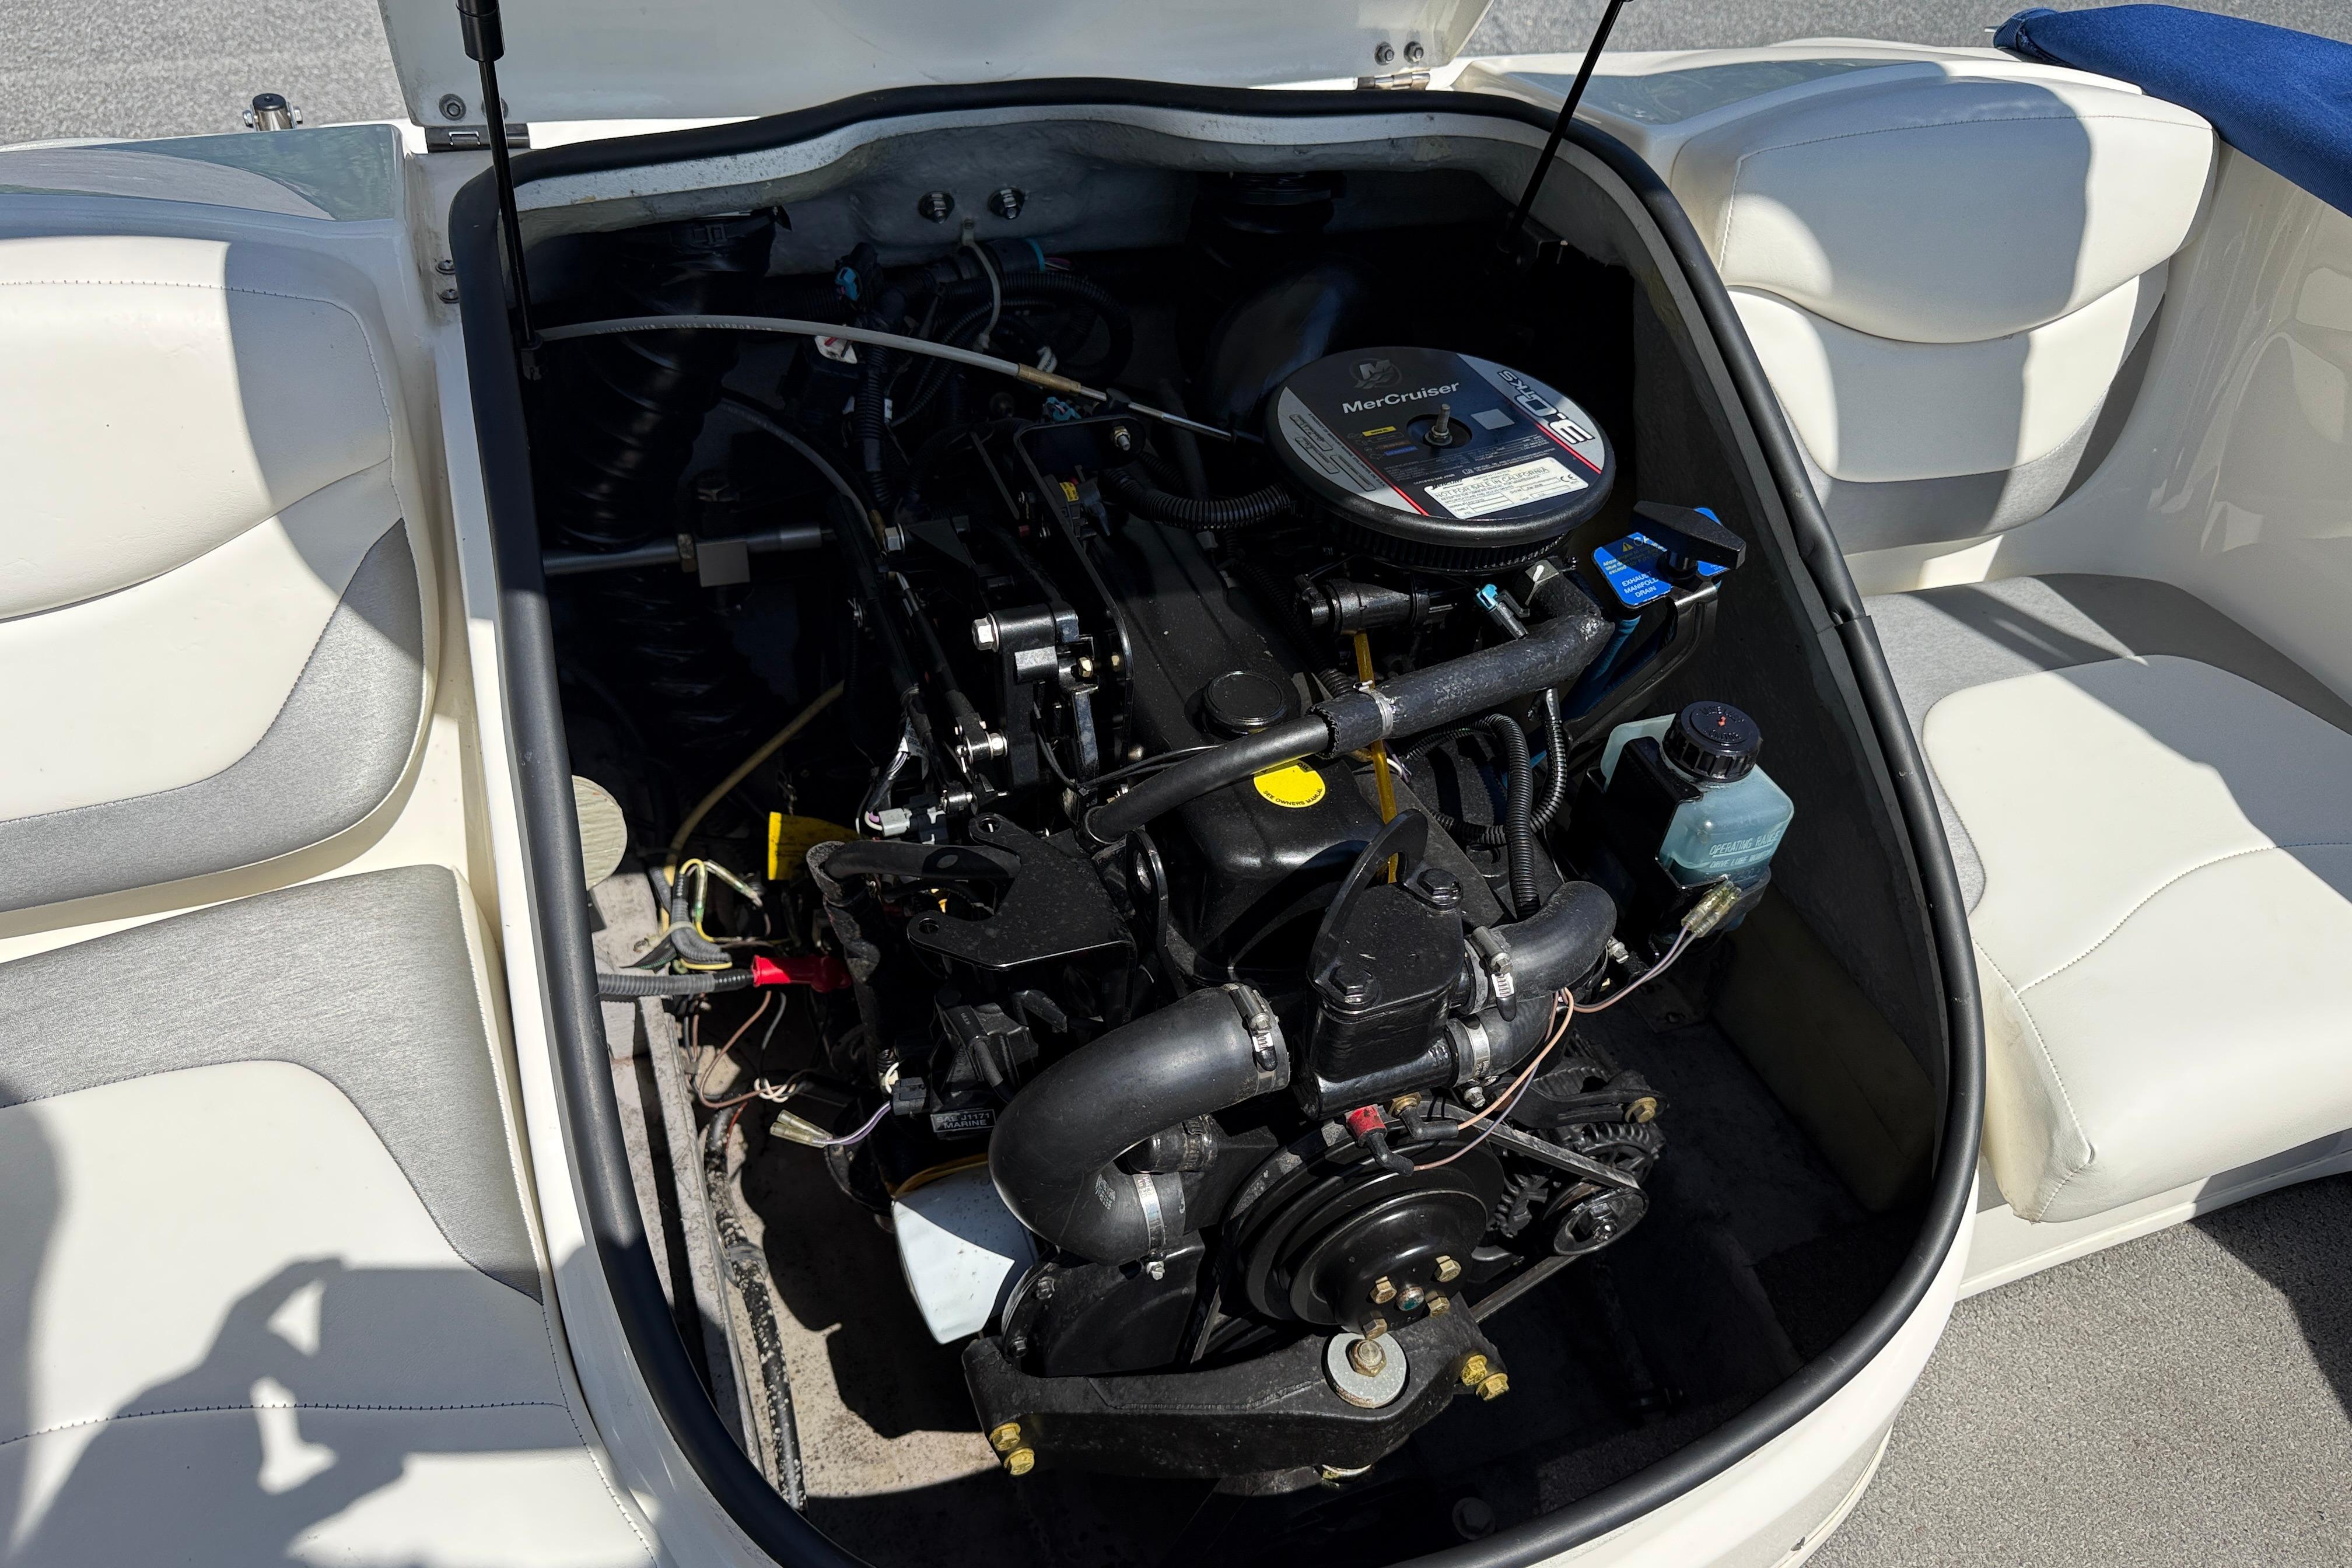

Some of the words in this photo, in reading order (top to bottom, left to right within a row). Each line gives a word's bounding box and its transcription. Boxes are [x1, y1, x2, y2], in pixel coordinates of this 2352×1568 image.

[1342, 382, 1460, 414] MerCruiser
[1514, 393, 1596, 445] 3.0
[1471, 482, 1491, 491] SALE
[1502, 467, 1548, 482] CALIFORNIA
[1622, 571, 1652, 587] EXHAUST
[1634, 586, 1657, 598] DRAIN
[1297, 762, 1308, 771] OIL
[1263, 790, 1276, 799] SEE
[1306, 787, 1323, 803] MANUAL
[1709, 837, 1753, 856] OPERATING
[1755, 830, 1781, 847] RANGE
[1709, 859, 1731, 869] DRIVE
[936, 1115, 958, 1123] SAE
[961, 1112, 990, 1121] J1171
[943, 1119, 988, 1129] MARINE
